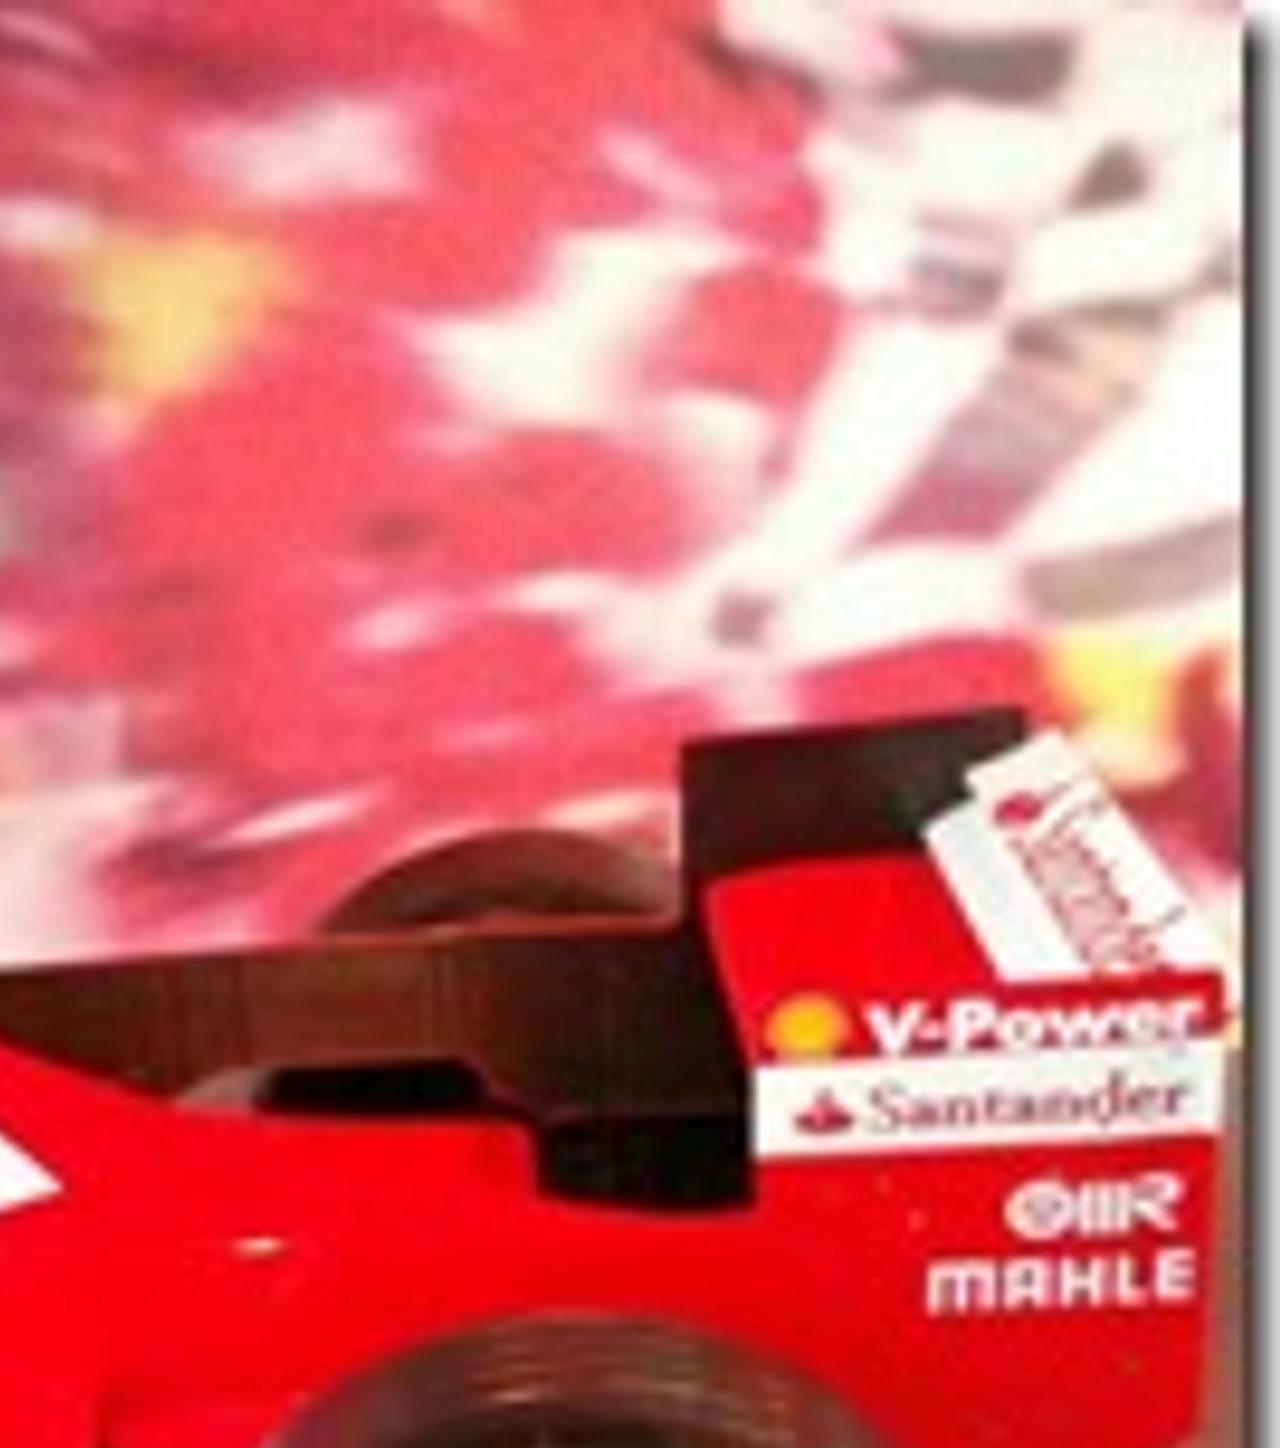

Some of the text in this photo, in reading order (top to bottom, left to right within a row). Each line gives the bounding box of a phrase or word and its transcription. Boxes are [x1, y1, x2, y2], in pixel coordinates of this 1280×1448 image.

[861, 996, 1206, 1056] V-Power
[866, 1068, 1190, 1134] Santander
[925, 1247, 1196, 1317] MAHLE
